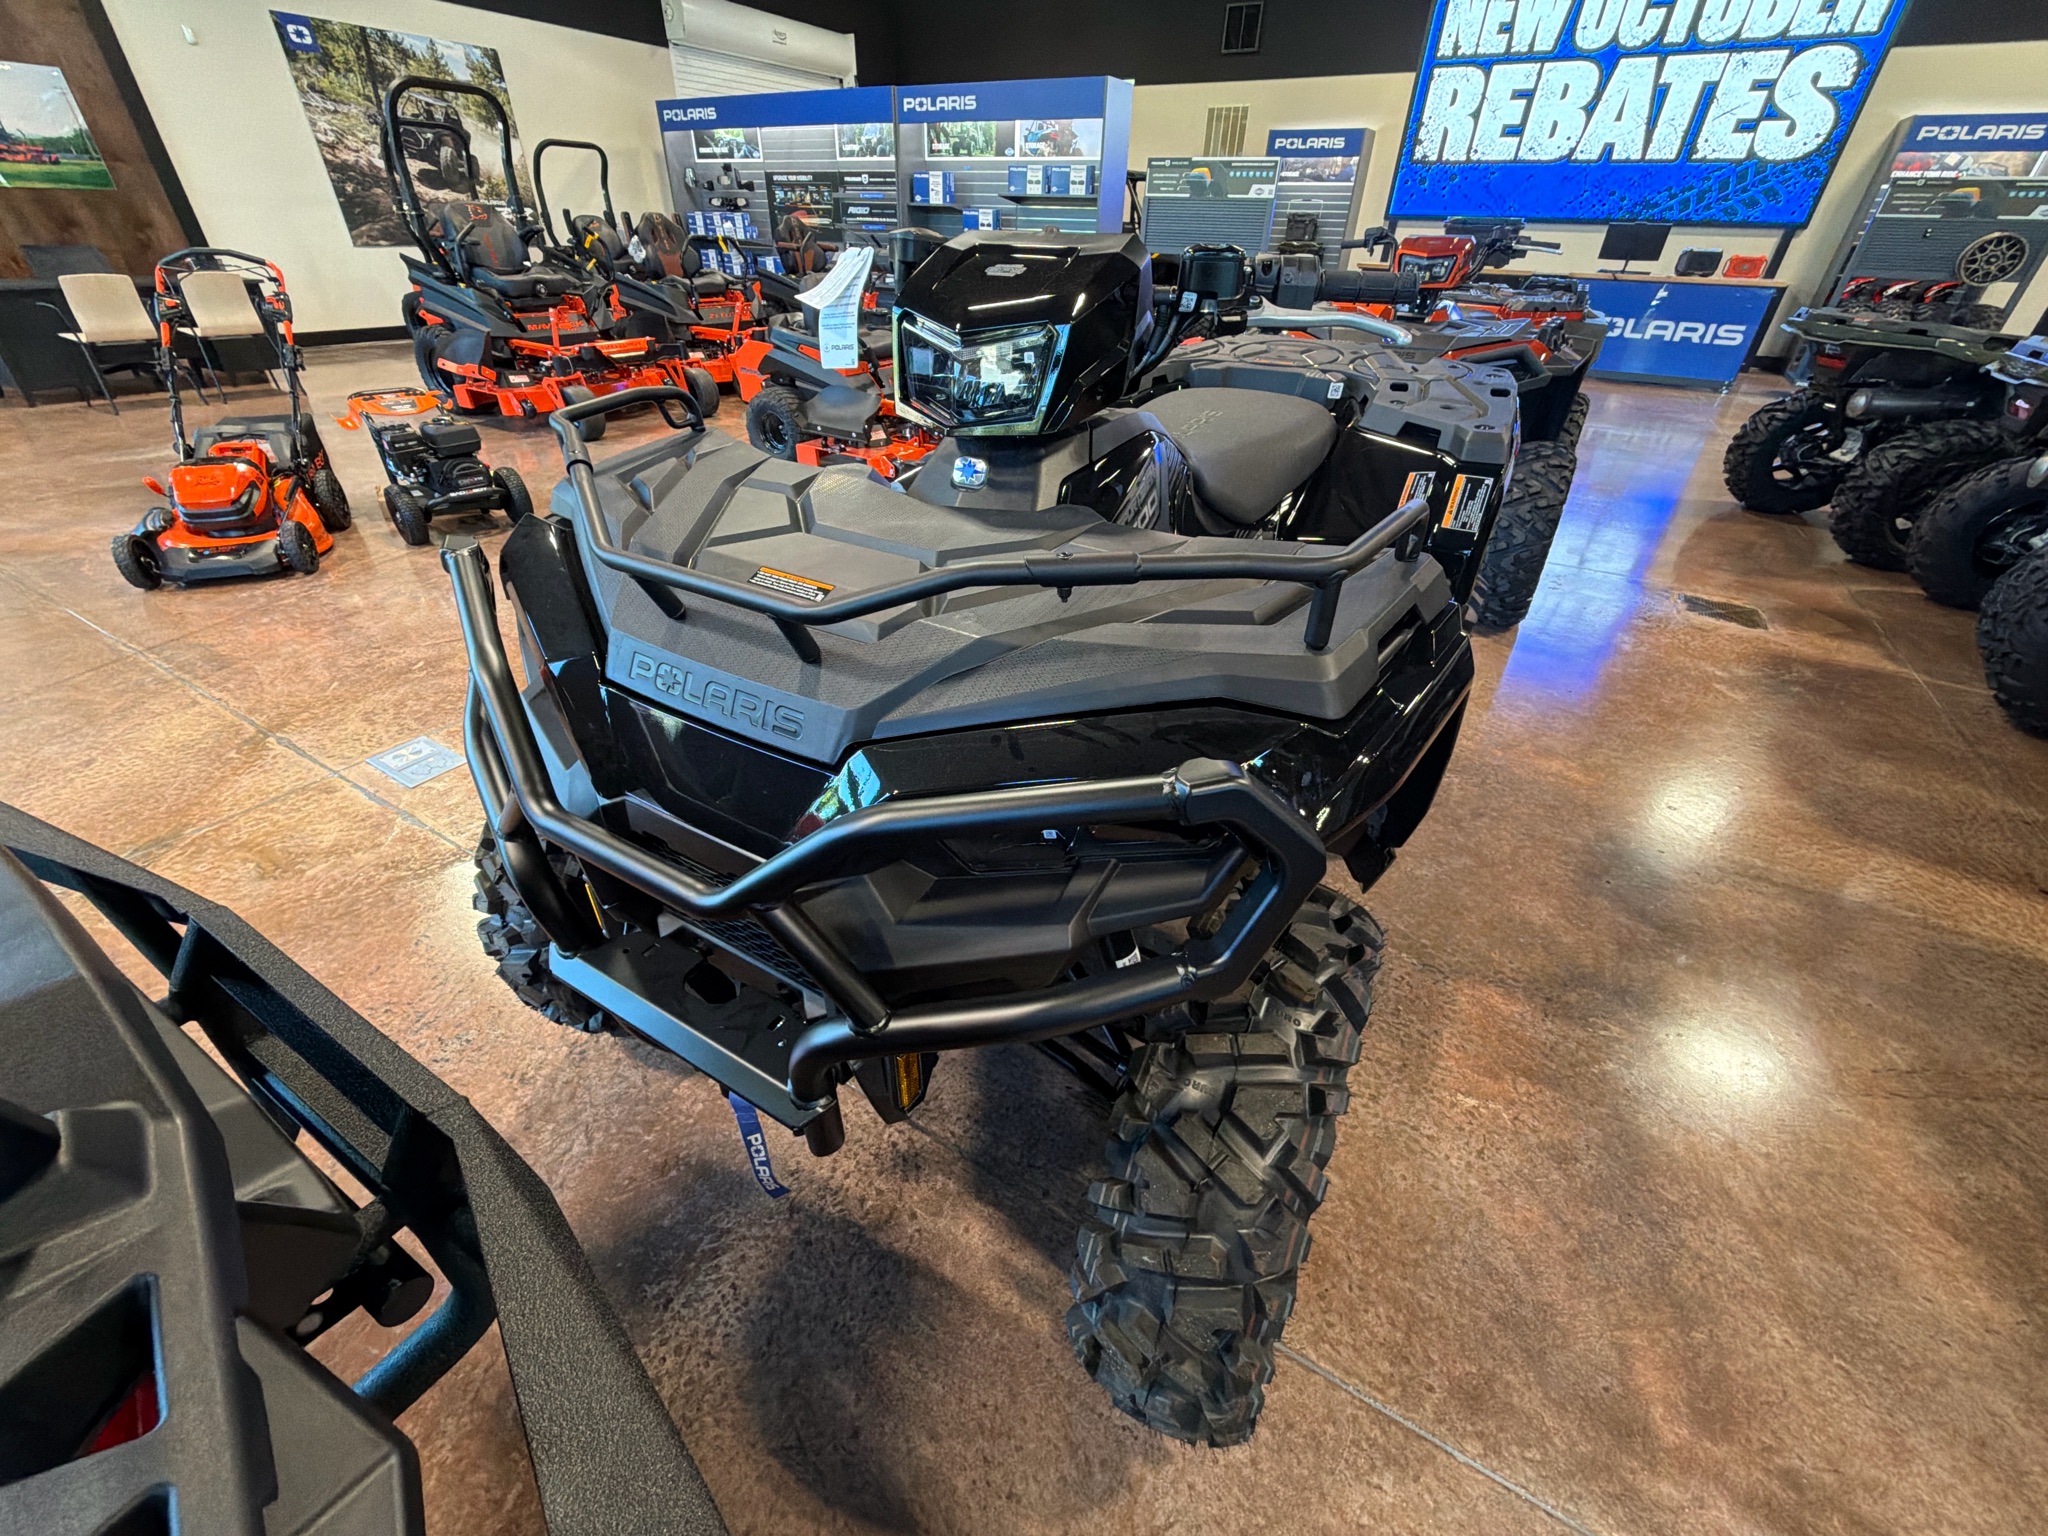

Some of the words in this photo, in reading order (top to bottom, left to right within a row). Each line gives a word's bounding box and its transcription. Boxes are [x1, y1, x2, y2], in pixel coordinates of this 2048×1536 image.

[1437, 0, 1571, 57] NEW
[902, 95, 977, 112] POLARIS
[1412, 44, 1859, 162] REBATES
[662, 107, 717, 122] POLARIS
[1916, 124, 2047, 141] POLARIS
[1274, 137, 1346, 150] POLARIS
[1890, 170, 1922, 178] ENHANCE
[1923, 170, 1941, 178] YOUR
[1605, 316, 1747, 346] OLARIS
[629, 651, 805, 741] POLARIS
